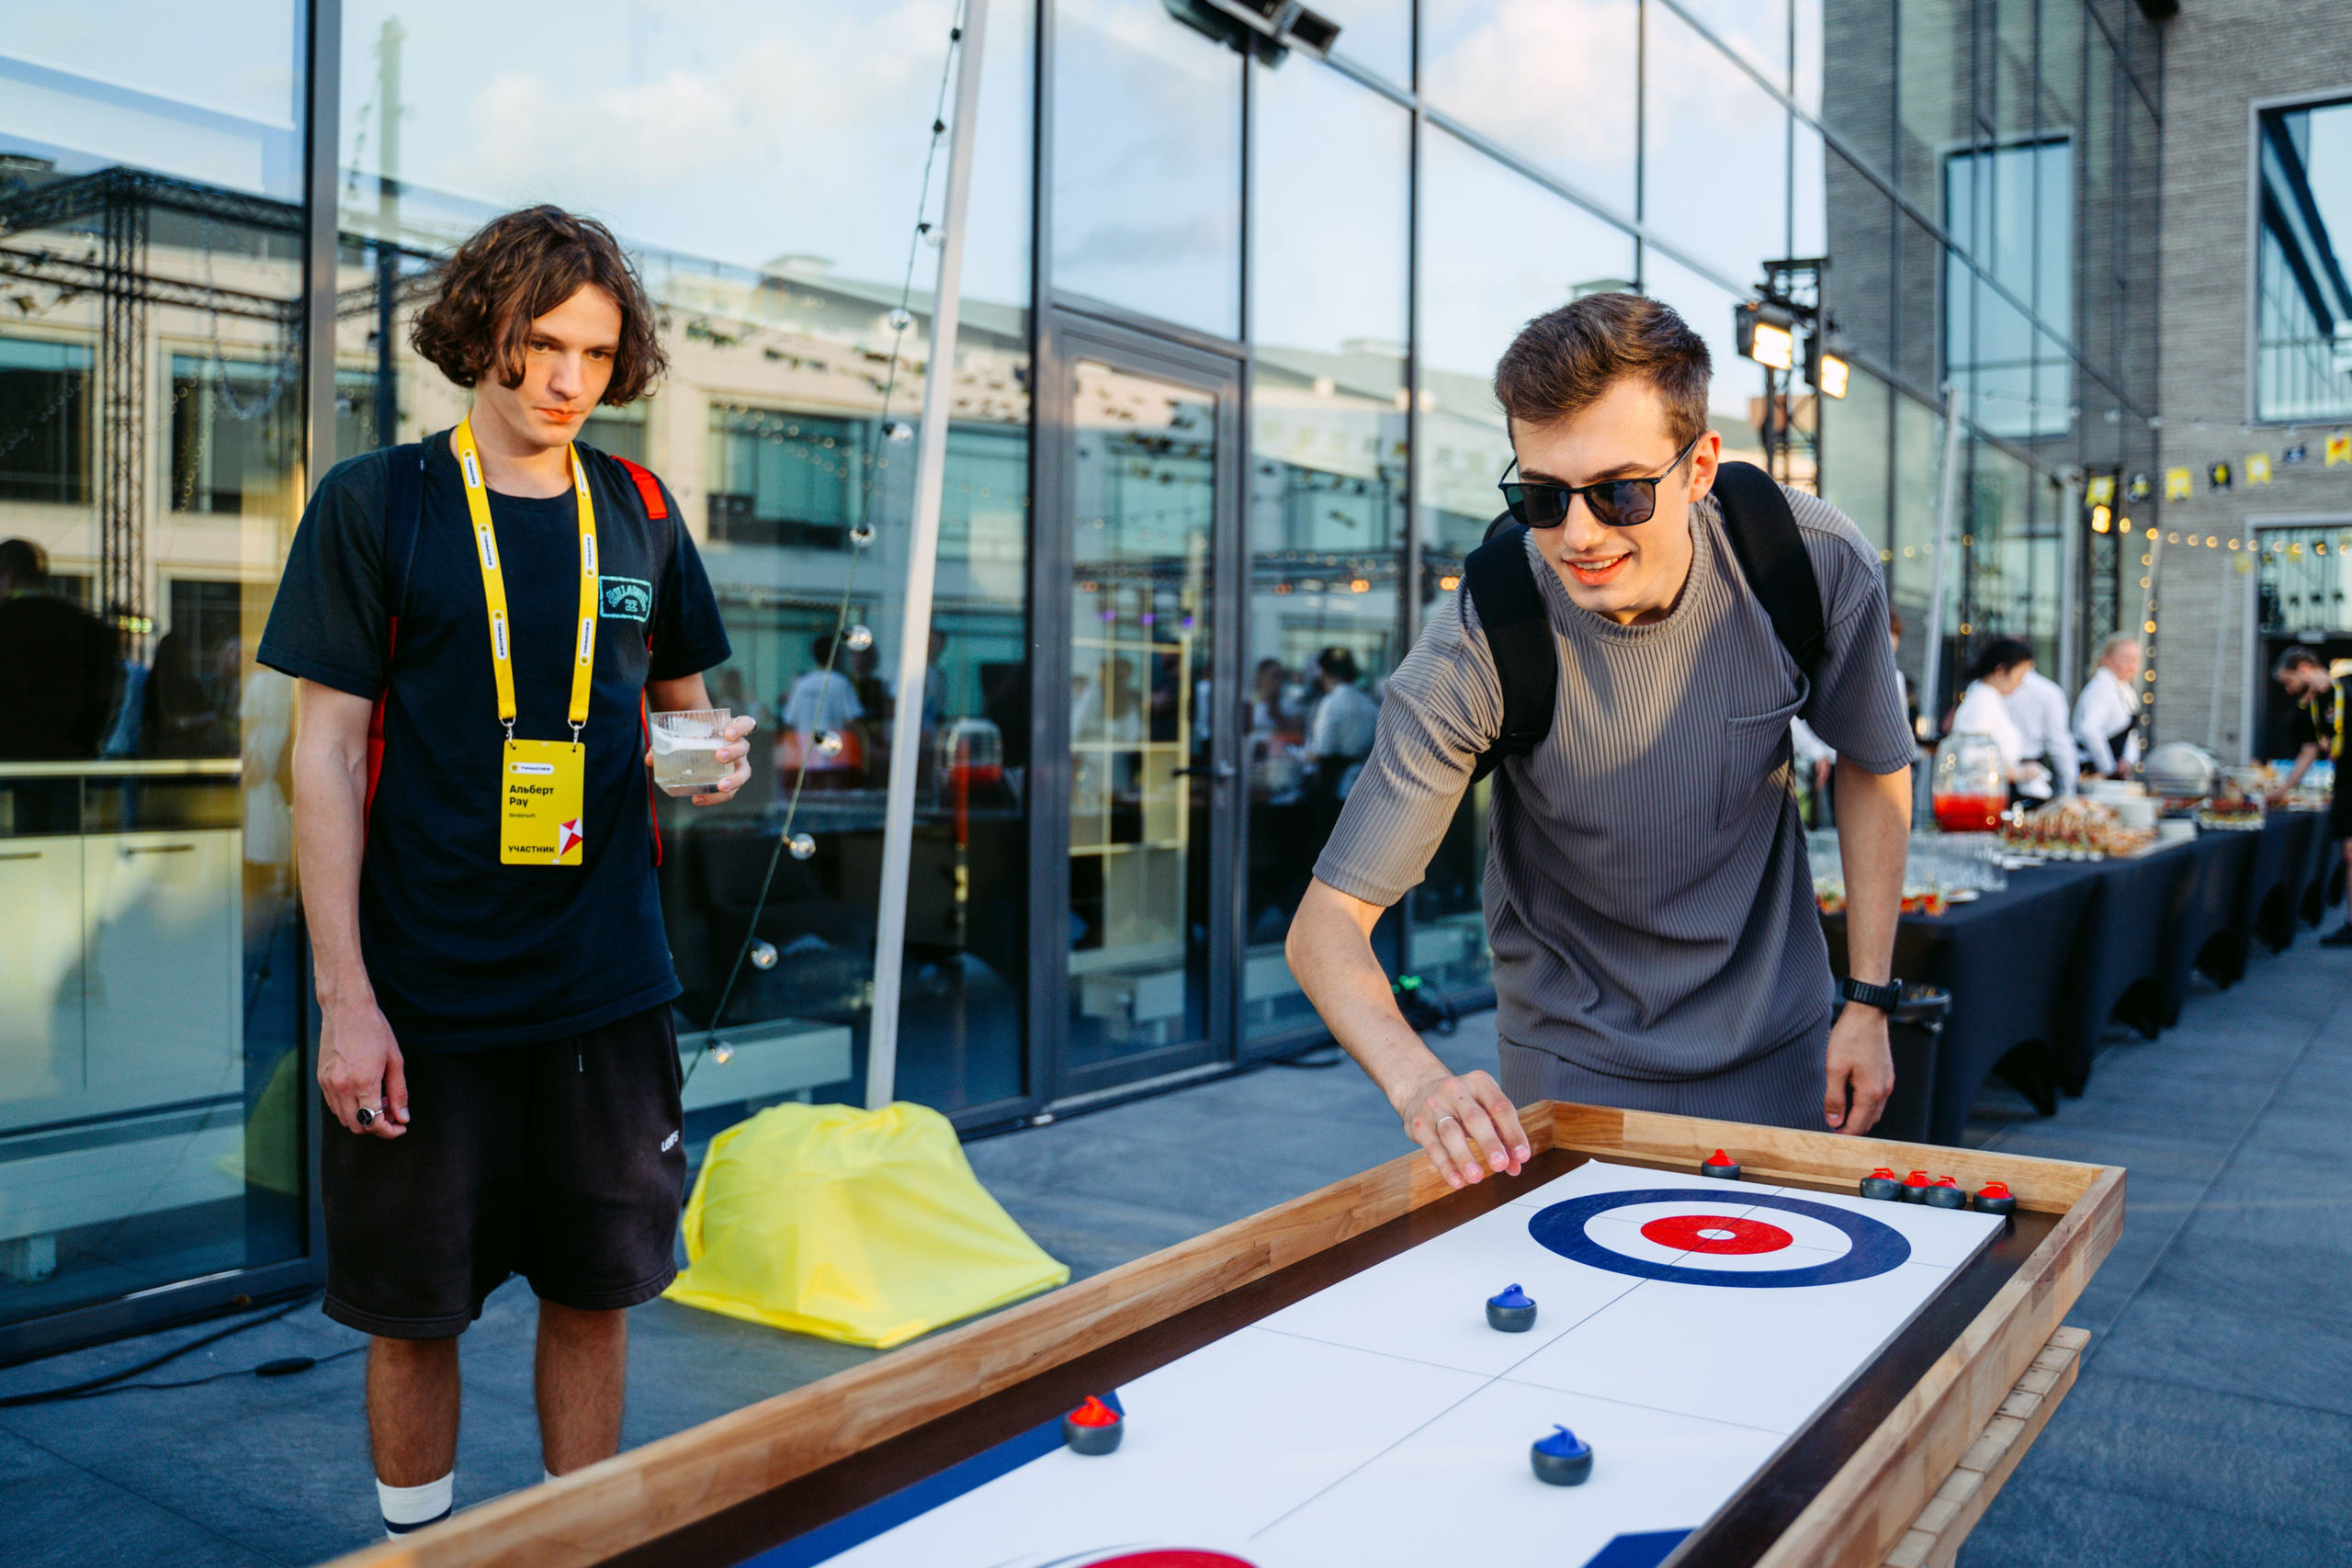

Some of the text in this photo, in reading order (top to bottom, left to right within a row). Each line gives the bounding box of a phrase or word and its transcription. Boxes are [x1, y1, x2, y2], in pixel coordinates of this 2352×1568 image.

[509, 784, 555, 796] Альберт
[509, 797, 528, 807] Рау
[508, 845, 555, 853] УЧАСТНИК
